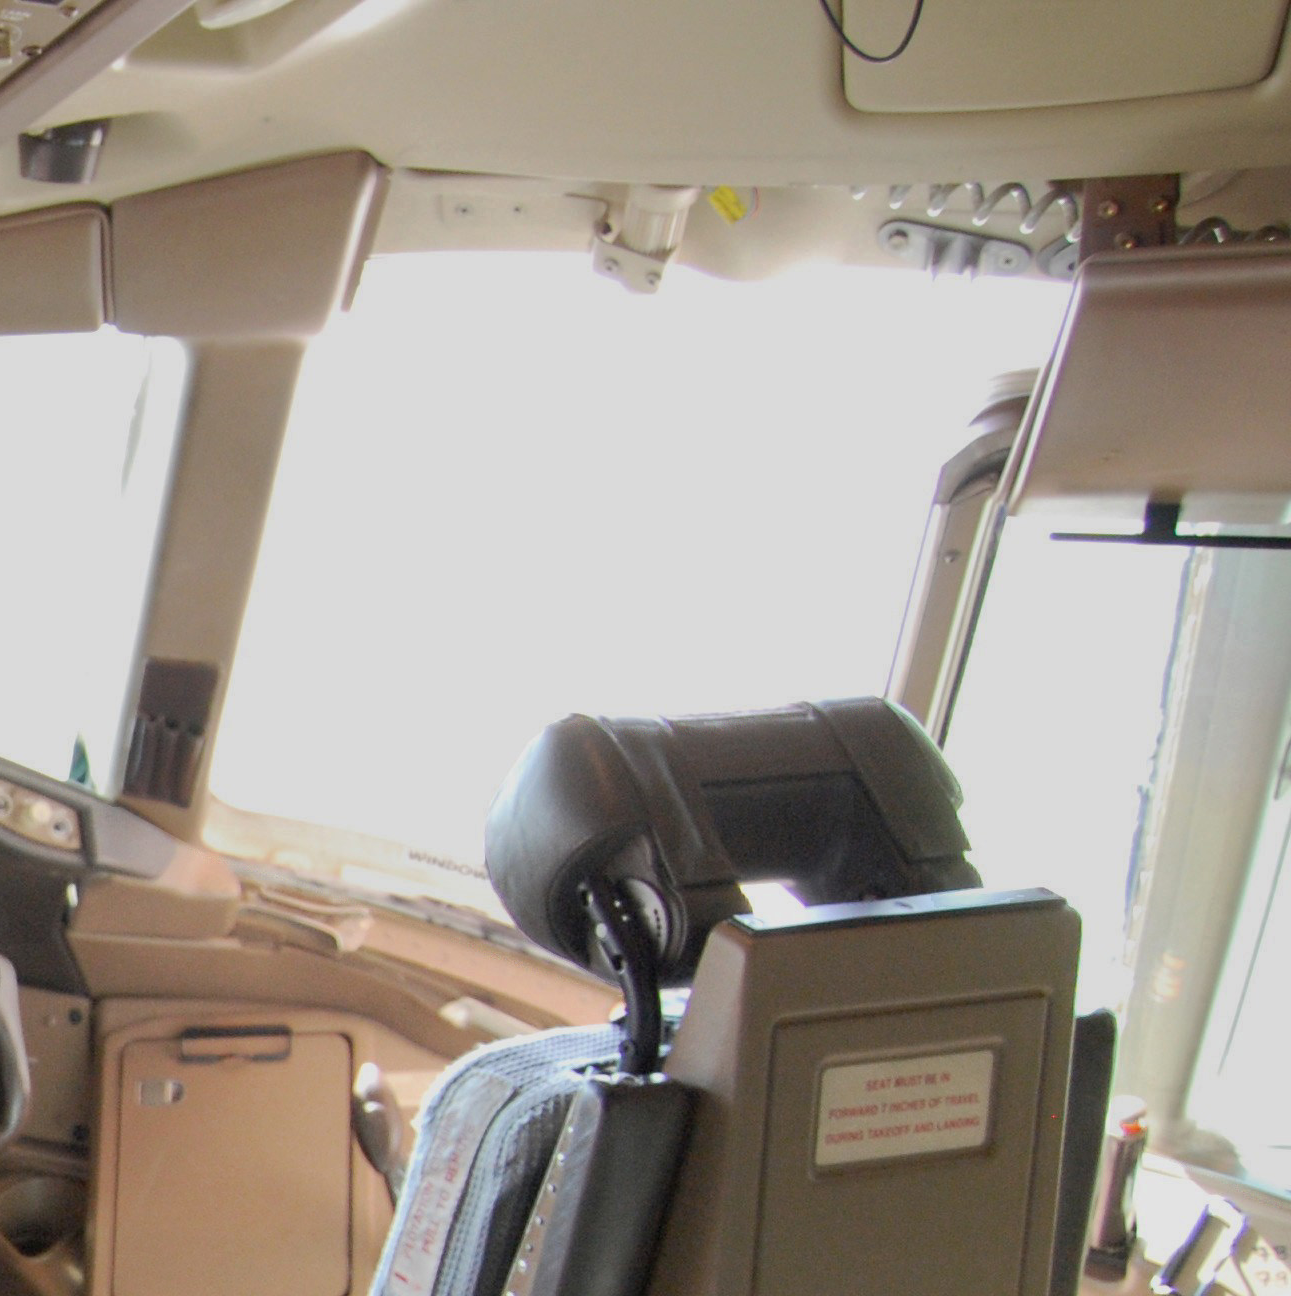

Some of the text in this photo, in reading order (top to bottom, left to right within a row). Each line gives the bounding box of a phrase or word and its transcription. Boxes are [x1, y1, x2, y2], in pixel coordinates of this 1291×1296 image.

[866, 1078, 892, 1092] SEAT
[894, 1074, 923, 1089] MUST
[828, 1103, 879, 1120] FORWARD
[889, 1098, 926, 1114] INCHES
[928, 1096, 943, 1109] OF
[945, 1092, 979, 1106] TRAVEL
[824, 1115, 980, 1146] DURING TAKEOFF AND LANDING
